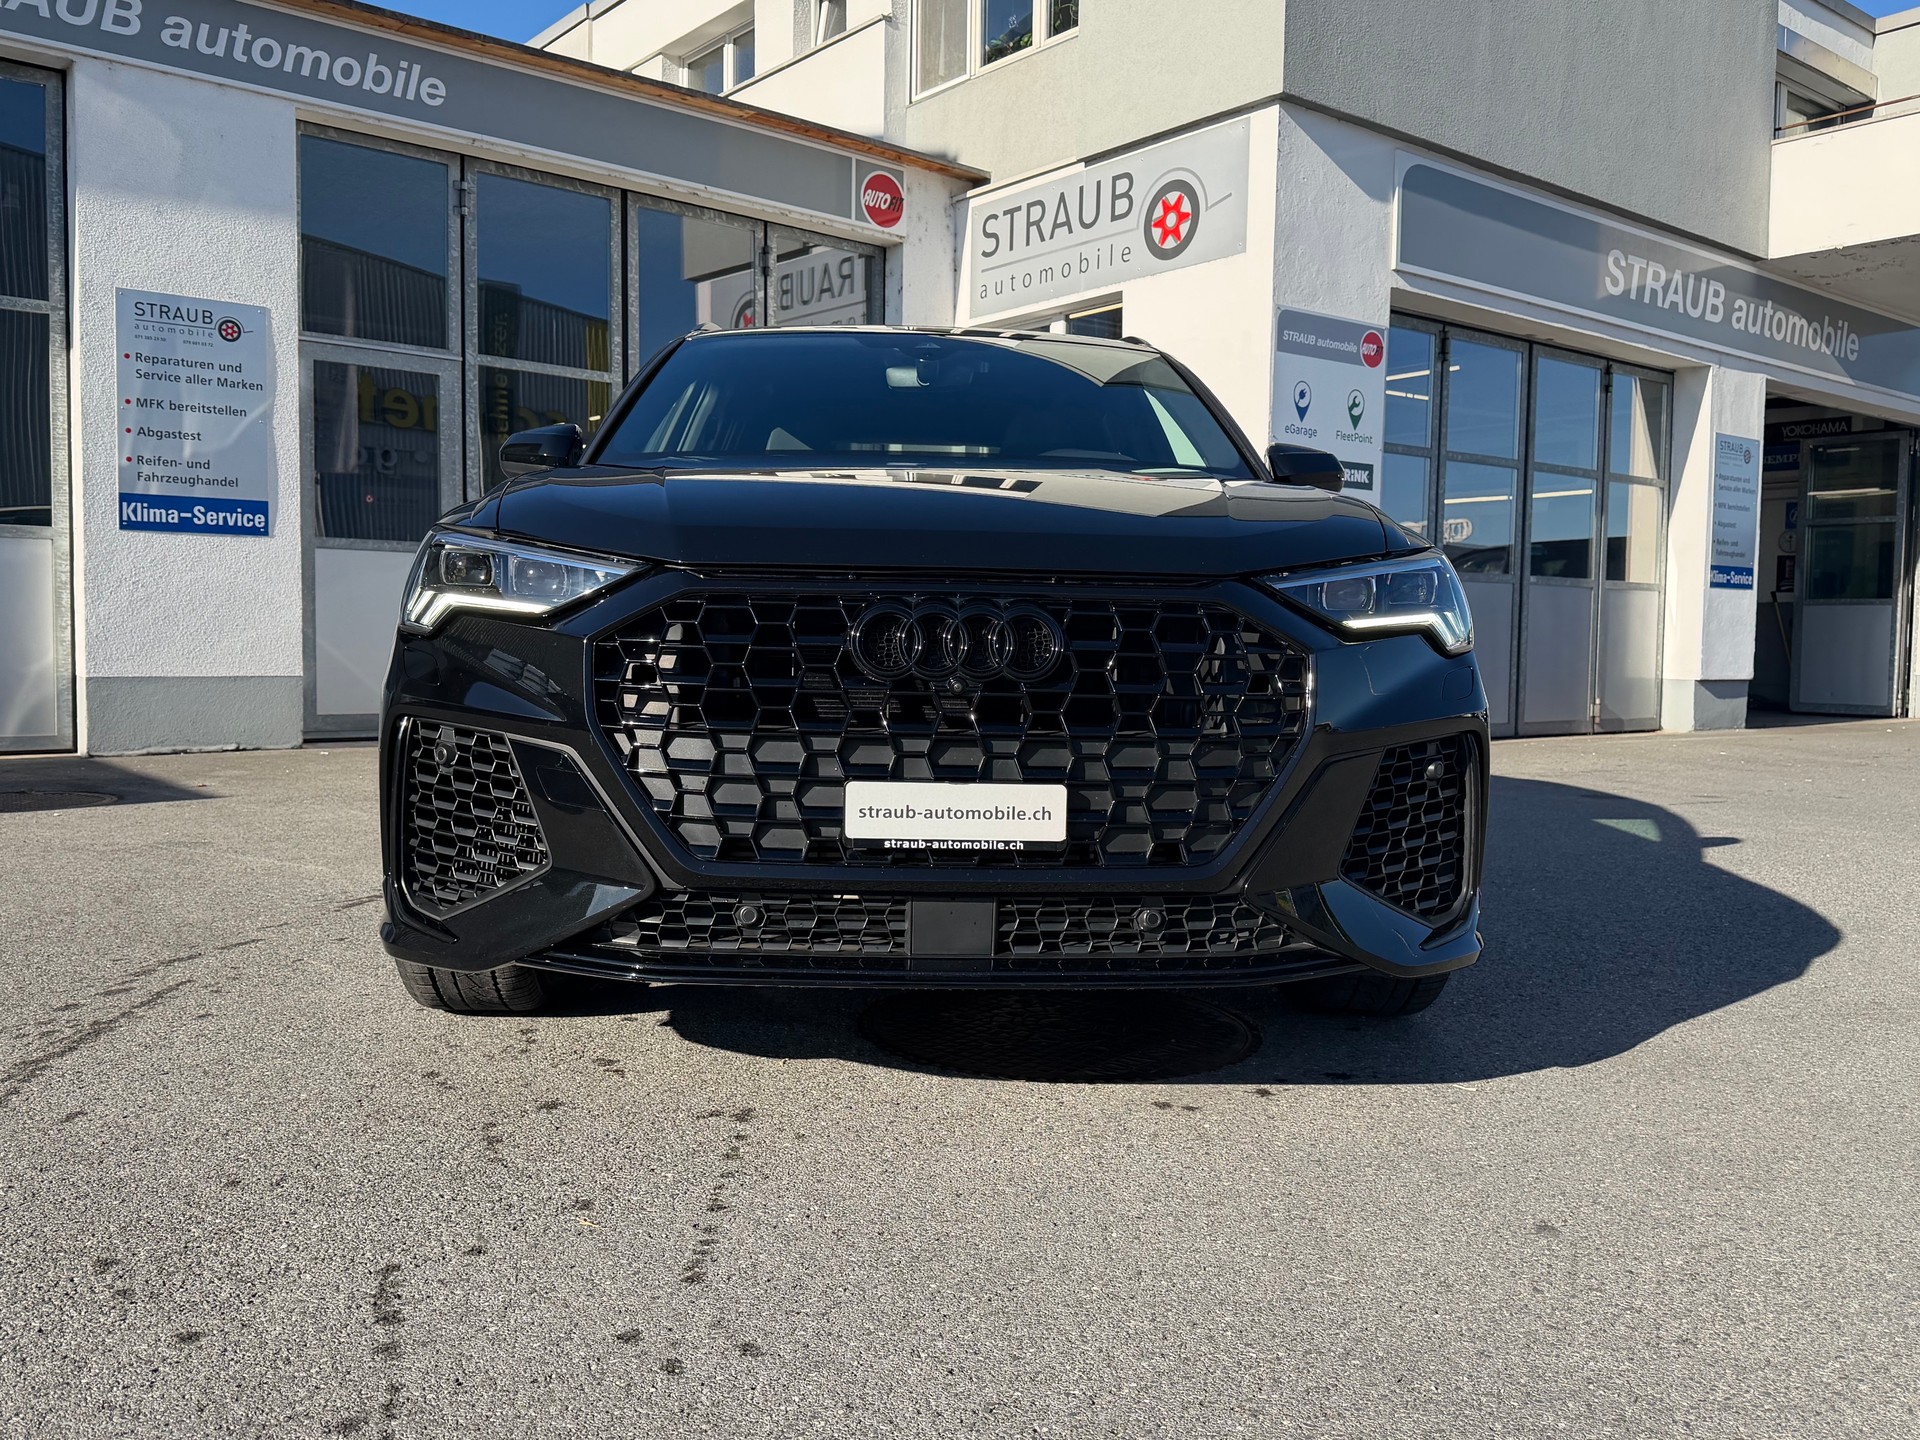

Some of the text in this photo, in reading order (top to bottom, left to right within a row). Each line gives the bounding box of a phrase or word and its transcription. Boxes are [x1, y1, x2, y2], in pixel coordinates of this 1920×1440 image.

[160, 15, 447, 107] automobile
[980, 171, 1134, 258] STRAUB
[979, 243, 1132, 299] automobile
[134, 301, 214, 325] STRAUB
[1605, 249, 1860, 361] STRAUB automobile
[134, 322, 214, 339] automobile
[1282, 330, 1358, 353] STRAUB automobile
[135, 352, 242, 374] Reparaturen und
[135, 368, 264, 391] Service aller Marken
[136, 397, 247, 418] MFK bereitstellen
[137, 426, 202, 442] Abgastest
[1284, 424, 1318, 439] eGarage
[1335, 430, 1373, 445] FleetPoint
[1781, 421, 1848, 437] YOKOHAMA
[1719, 440, 1744, 454] STRAUB
[137, 455, 211, 470] Reifen- und
[137, 471, 239, 488] Fahrzeughandel
[121, 501, 266, 528] Klima-Service
[1711, 569, 1753, 586] Klima-Service
[858, 804, 1052, 821] straub-automobile.ch
[883, 839, 1024, 851] straub-automobile.ch
